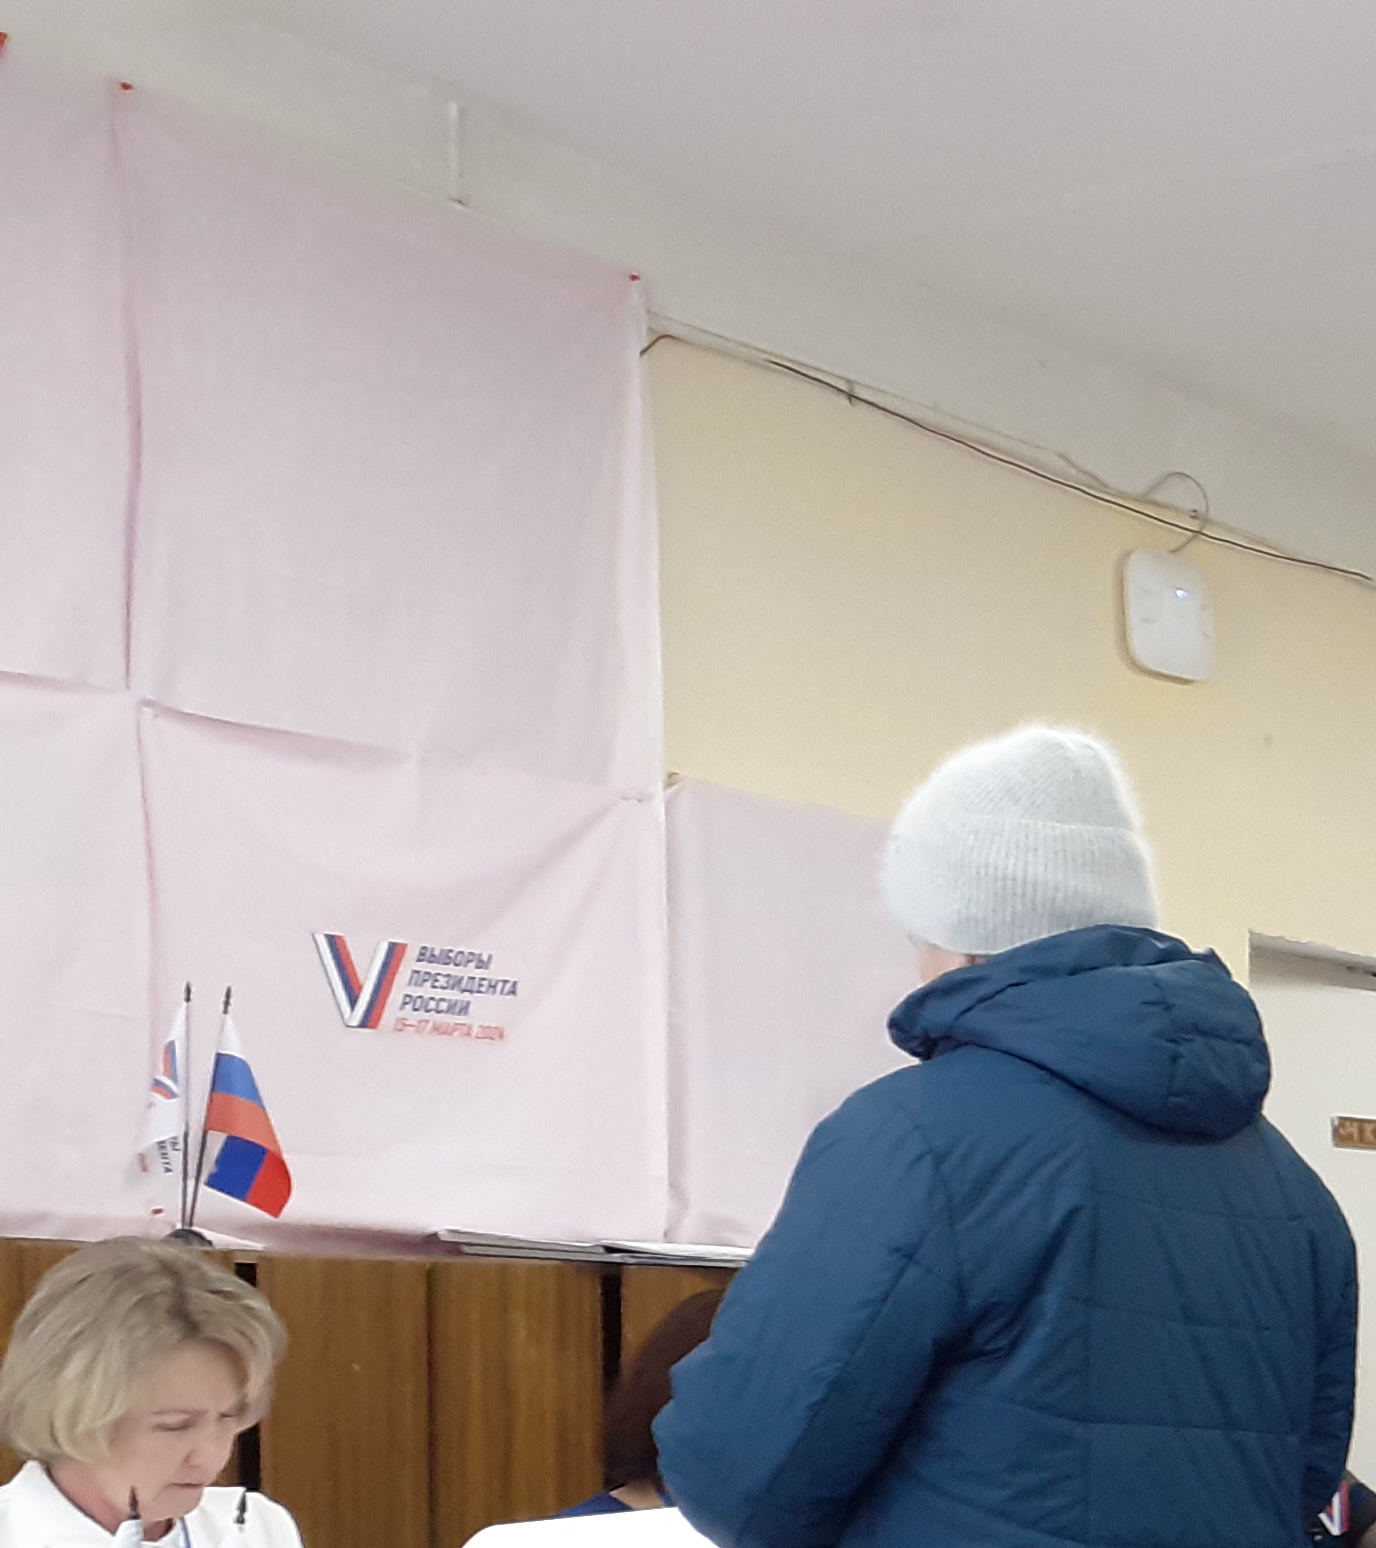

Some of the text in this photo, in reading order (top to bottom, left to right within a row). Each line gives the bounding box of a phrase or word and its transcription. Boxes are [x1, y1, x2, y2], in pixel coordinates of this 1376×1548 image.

[416, 946, 493, 970] ВЫБОРЫ
[407, 969, 519, 997] ПРЕЗИДЕНТА
[400, 993, 472, 1017] РОССИИ
